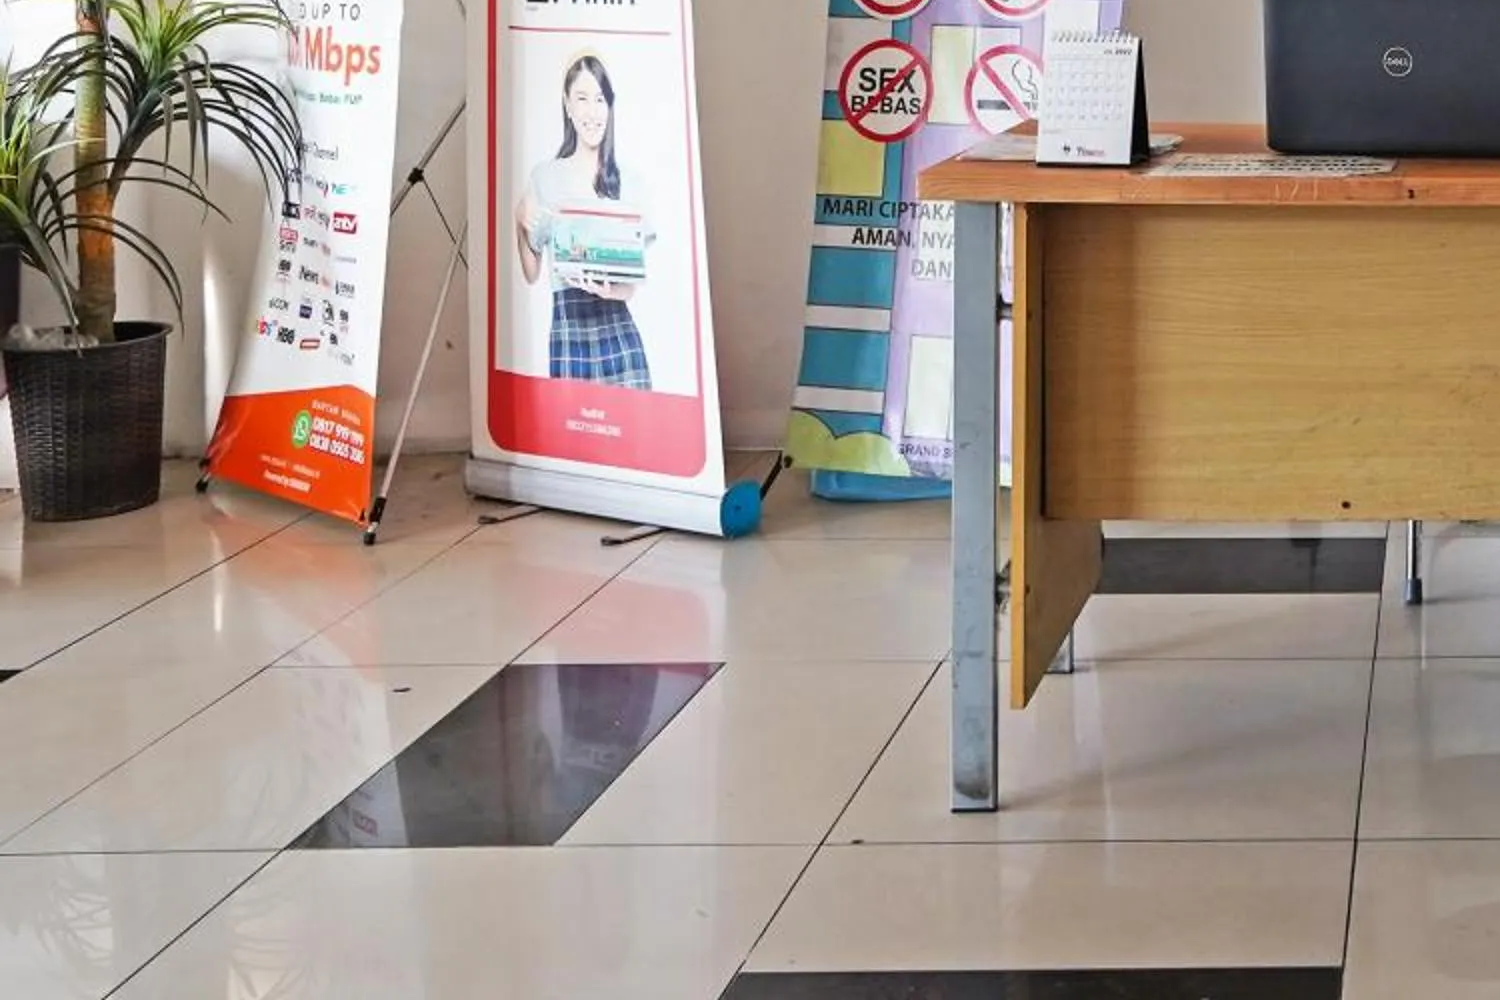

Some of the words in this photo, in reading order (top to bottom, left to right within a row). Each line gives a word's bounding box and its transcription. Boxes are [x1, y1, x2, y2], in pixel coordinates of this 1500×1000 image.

[339, 3, 362, 21] TO
[859, 68, 916, 93] SEX
[851, 95, 921, 115] BEBAS
[823, 199, 873, 217] MARI
[880, 200, 953, 220] CIPTAKA
[911, 259, 953, 278] DAN
[898, 442, 940, 458] GRAND
